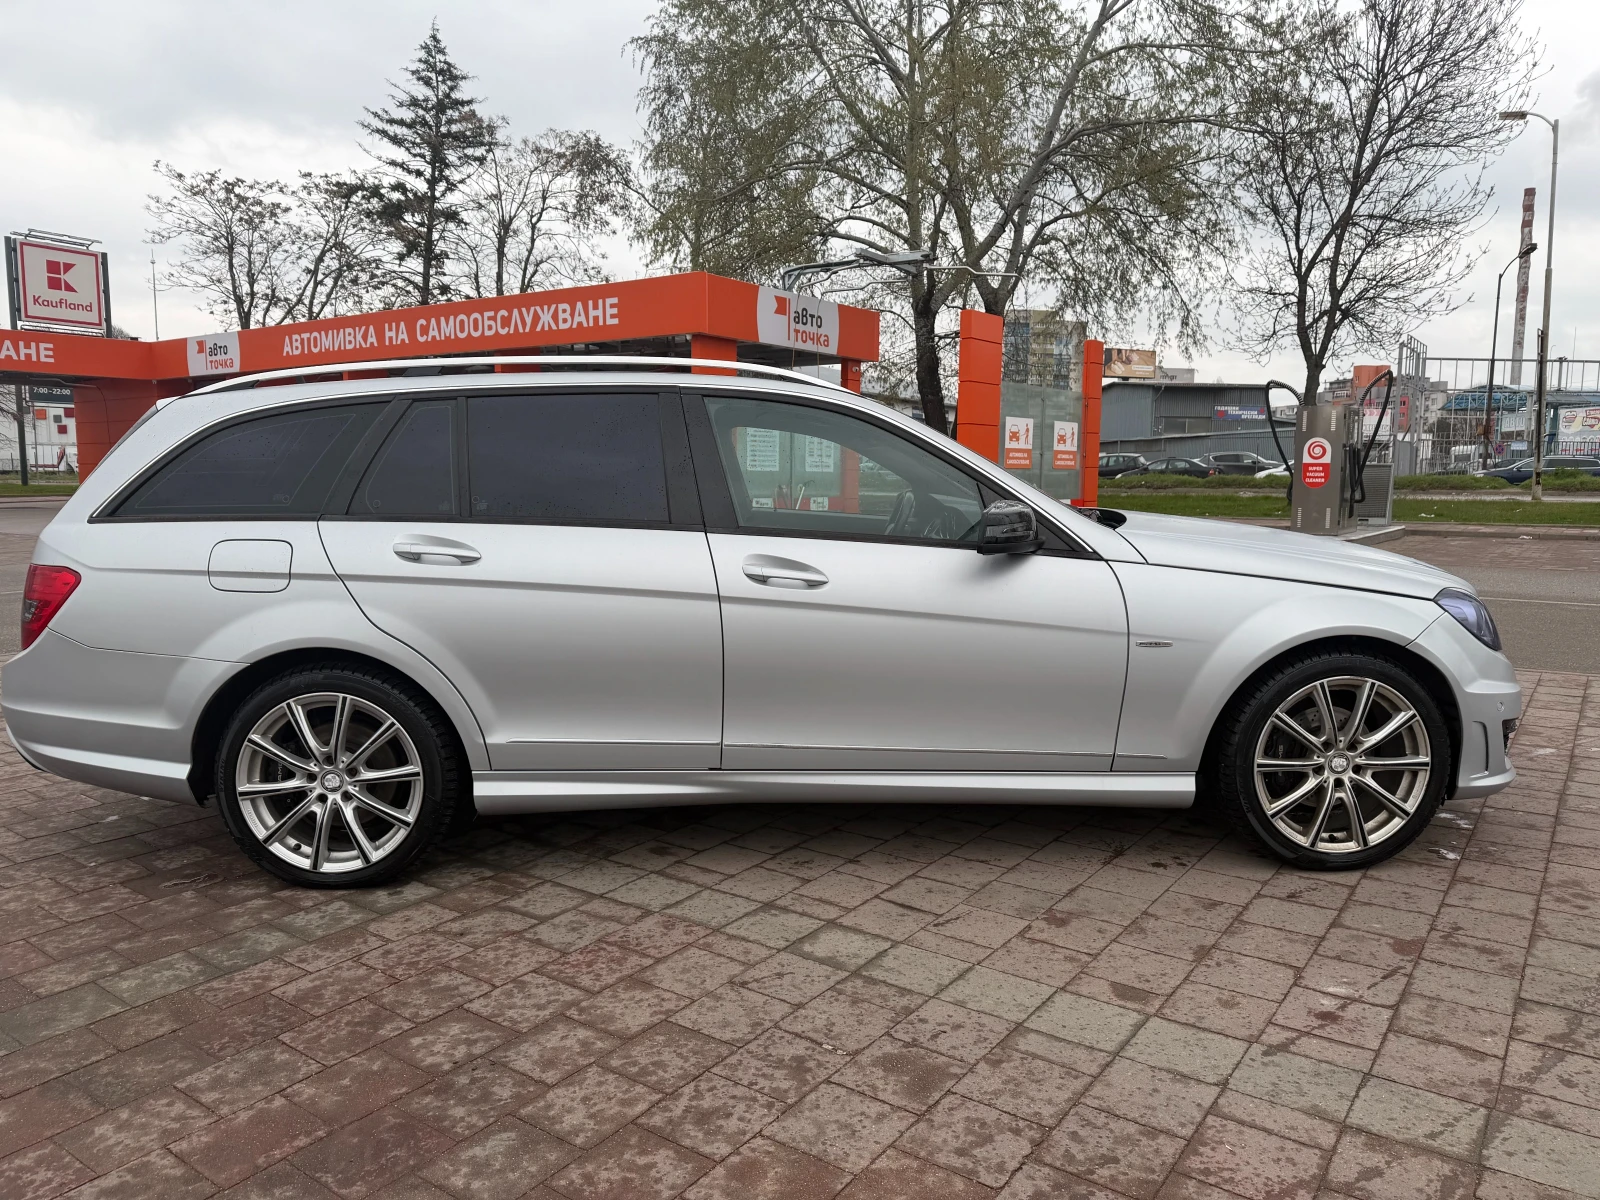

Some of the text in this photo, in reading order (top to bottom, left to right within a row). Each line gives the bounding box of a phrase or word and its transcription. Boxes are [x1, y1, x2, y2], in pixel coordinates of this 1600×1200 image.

[32, 294, 93, 313] Kaufland
[282, 297, 619, 357] АВТОМИВКА НА САМООБСЛУЖВАНЕ
[793, 328, 830, 348] точка
[0, 339, 55, 363] АНЕ
[208, 356, 234, 370] точка
